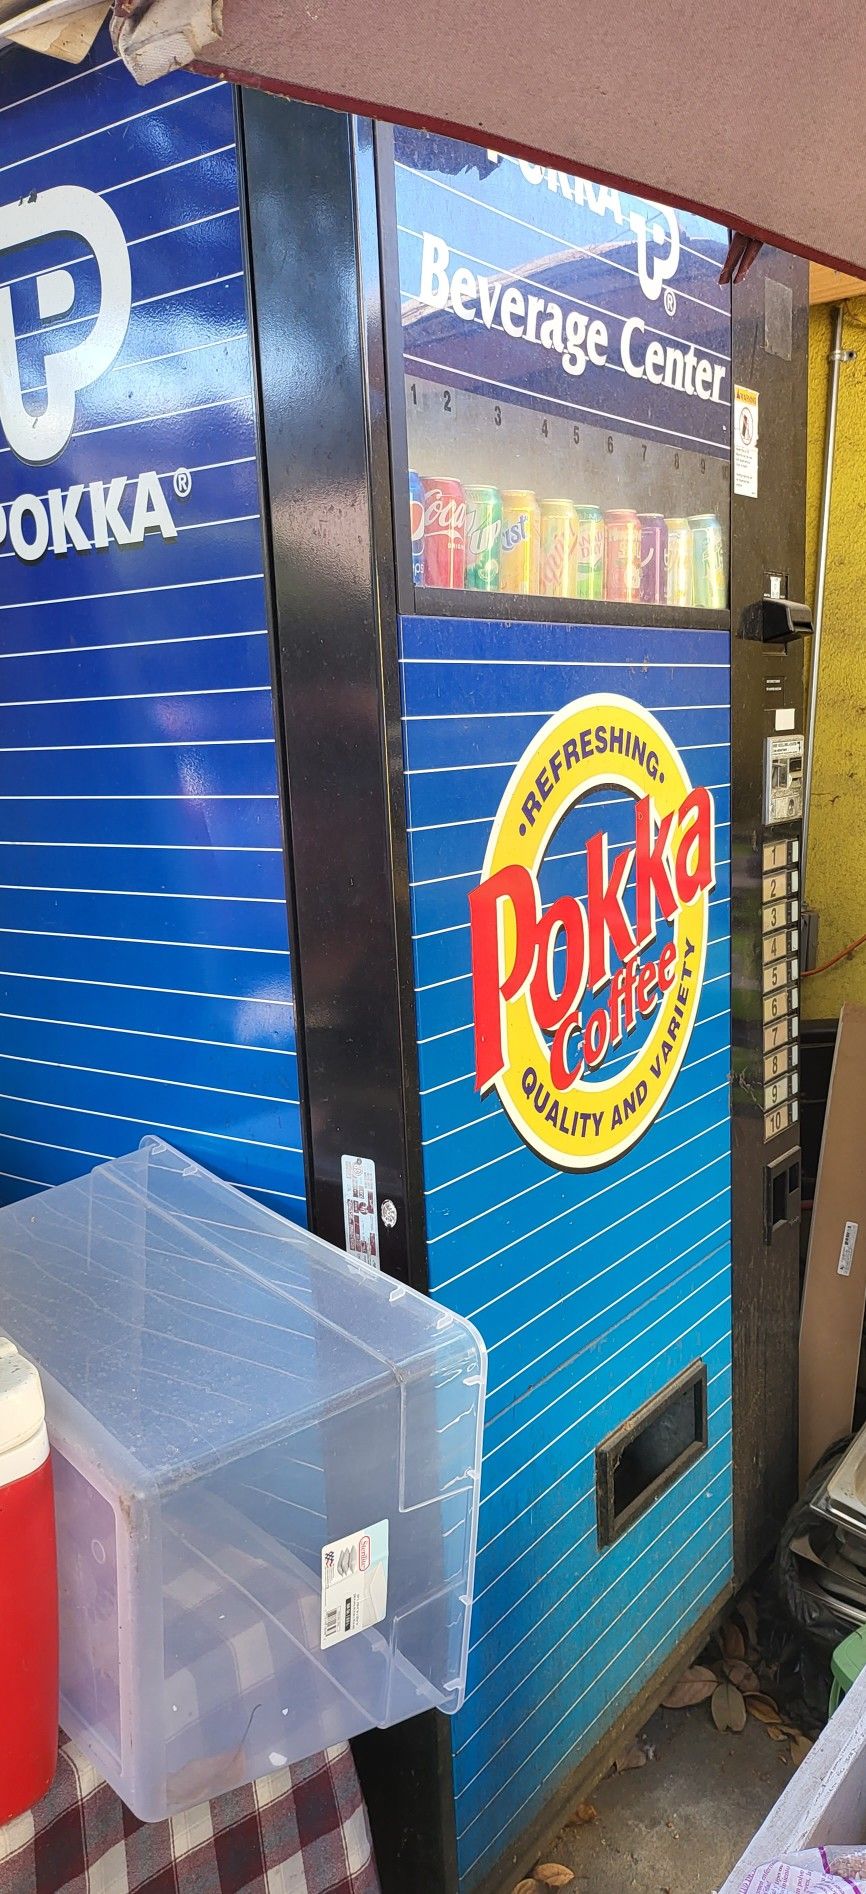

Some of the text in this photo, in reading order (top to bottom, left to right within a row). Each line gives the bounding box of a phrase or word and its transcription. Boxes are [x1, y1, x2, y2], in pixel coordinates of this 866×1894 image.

[420, 231, 726, 401] Beverage Center
[410, 383, 417, 405] 1
[443, 390, 452, 412] 2
[494, 405, 502, 426] 3
[541, 418, 549, 438] 4
[573, 425, 580, 445] 5
[607, 435, 614, 454] 6
[641, 444, 647, 462] 7
[674, 453, 680, 469] 8
[520, 725, 661, 827] REFRESHING
[770, 848, 776, 865] 1
[770, 880, 777, 898] 2
[770, 908, 777, 926] 3
[467, 786, 715, 1092] Pokka
[770, 938, 777, 956] 4
[771, 968, 778, 986] 5
[549, 940, 678, 1091] Coffee
[771, 998, 778, 1016] 6
[521, 936, 696, 1138] QUALITY AND VARIETY
[771, 1028, 778, 1046] 7
[772, 1056, 778, 1075] 8
[772, 1085, 778, 1103] 9
[770, 1112, 782, 1132] 10
